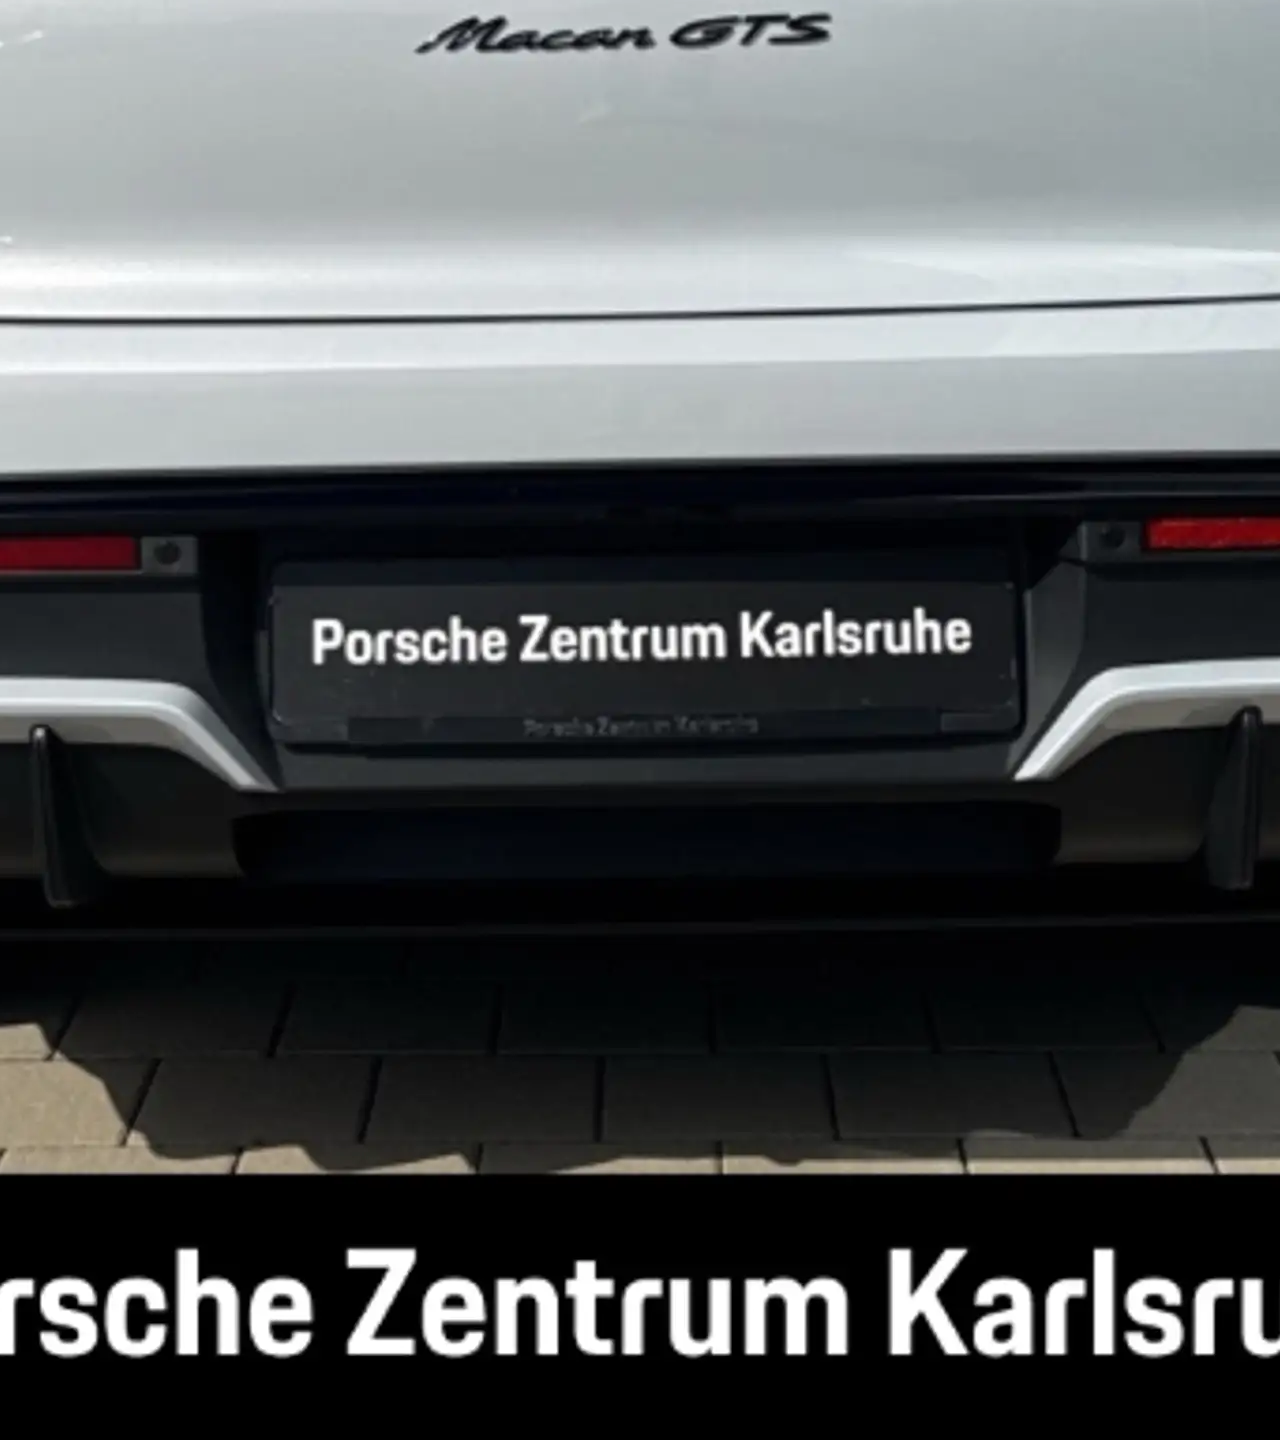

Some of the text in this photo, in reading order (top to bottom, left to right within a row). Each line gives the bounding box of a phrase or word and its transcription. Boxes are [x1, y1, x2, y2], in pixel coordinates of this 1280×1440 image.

[416, 13, 832, 54] Macan GTS
[312, 606, 972, 666] Porsche Zentrum Karlsruhe
